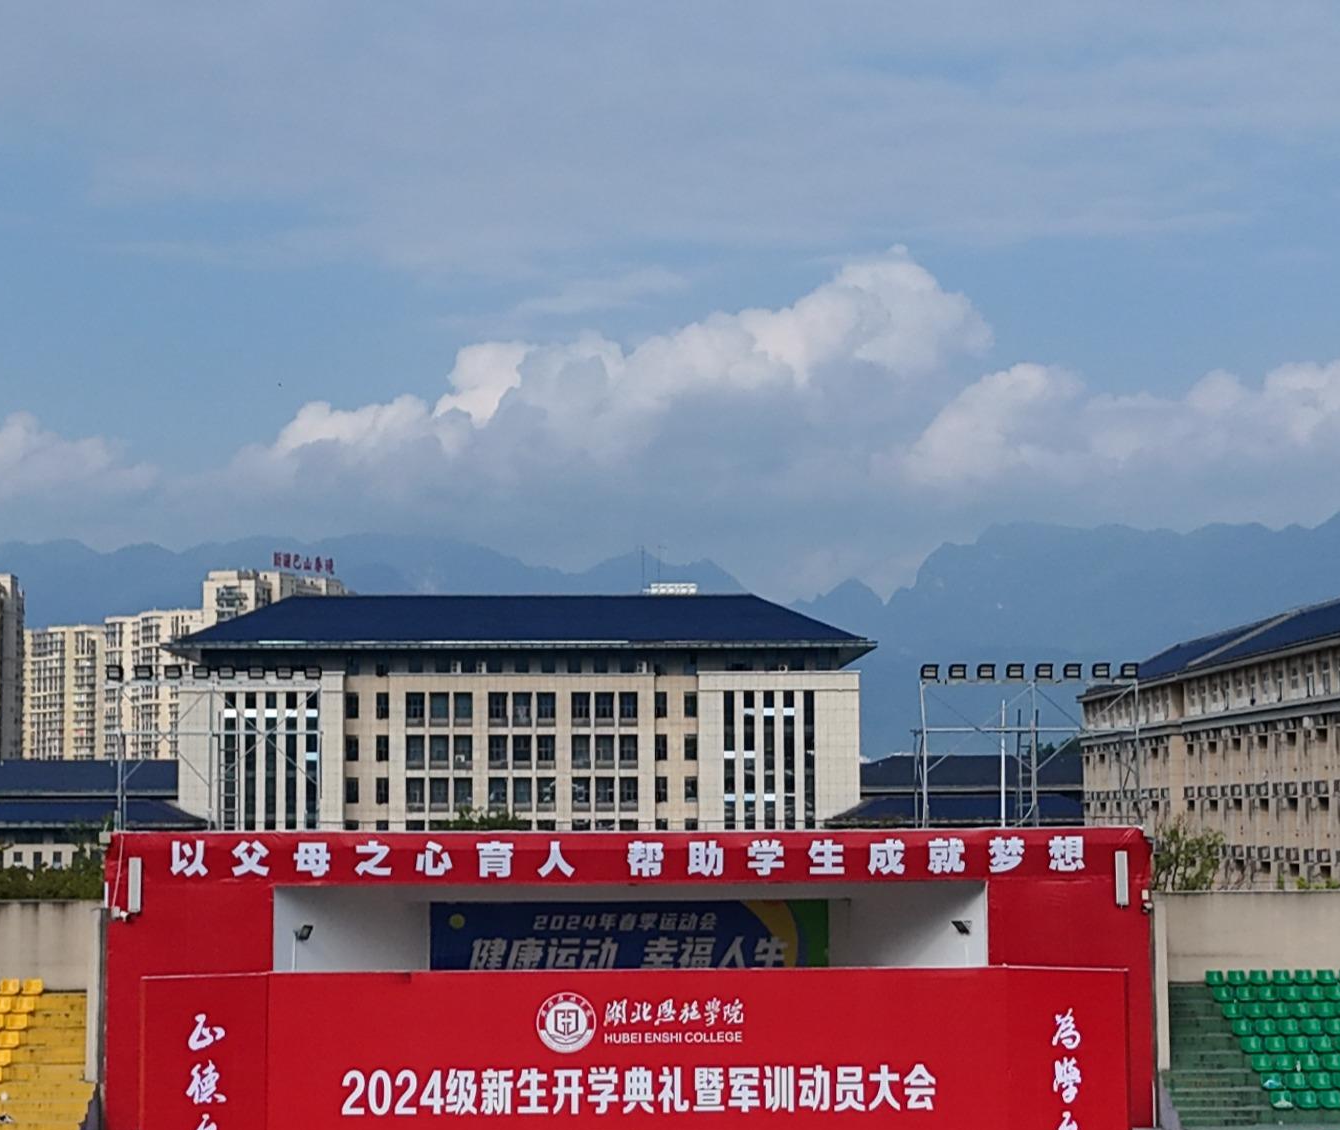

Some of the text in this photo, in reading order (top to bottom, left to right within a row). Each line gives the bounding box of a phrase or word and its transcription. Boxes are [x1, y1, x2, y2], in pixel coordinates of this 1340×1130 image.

[170, 834, 1085, 878] 以父母之心育人 帮助学生成就梦想
[532, 912, 719, 931] 2024年春季运动会
[470, 937, 620, 970] 健康运动
[604, 1031, 742, 1044] HUBEI ENSHI COLLEGE
[341, 1063, 936, 1116] 2024级新生开学典礼暨军训动员大会
